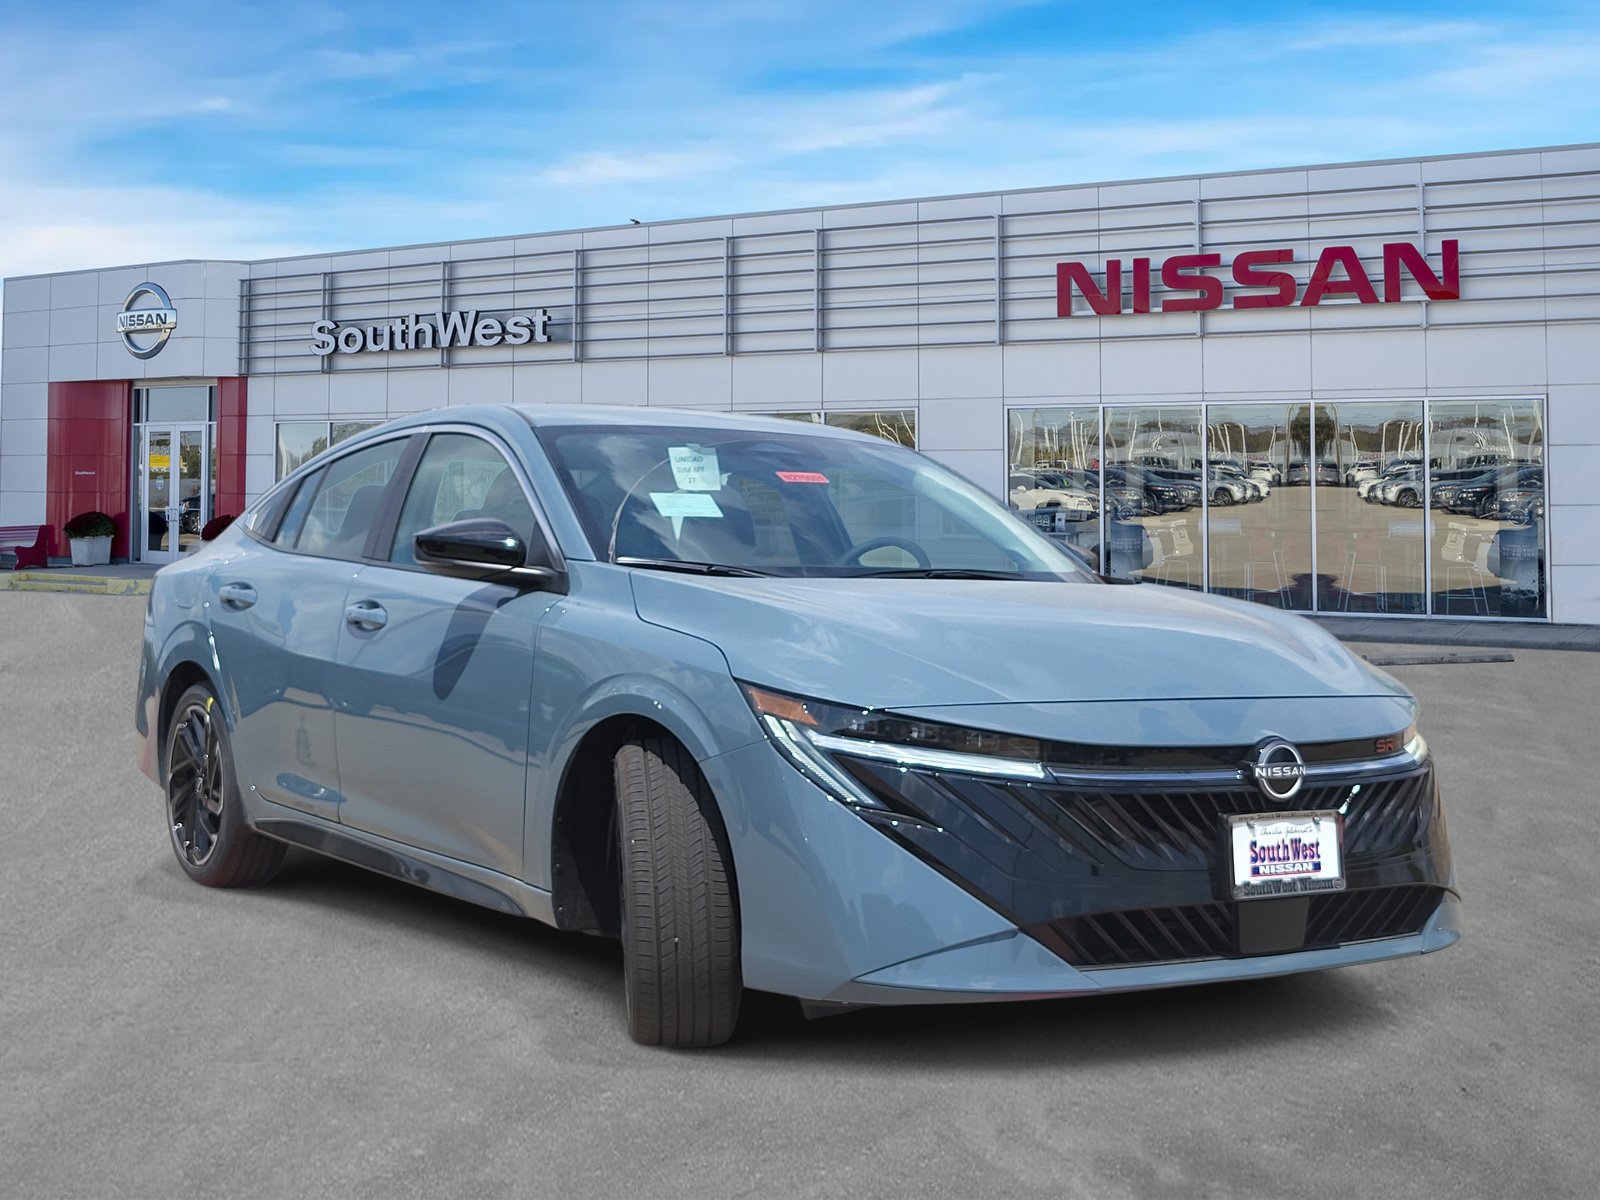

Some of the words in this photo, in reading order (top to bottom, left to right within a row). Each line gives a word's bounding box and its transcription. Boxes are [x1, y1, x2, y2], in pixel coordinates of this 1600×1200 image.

[1056, 239, 1460, 317] NISSAN
[118, 312, 168, 329] NISSAN
[309, 308, 551, 357] SouthWest
[1376, 739, 1395, 752] SR
[1255, 765, 1306, 778] NISSAN
[1259, 862, 1313, 874] NISSAN
[1298, 876, 1334, 892] Nissan
